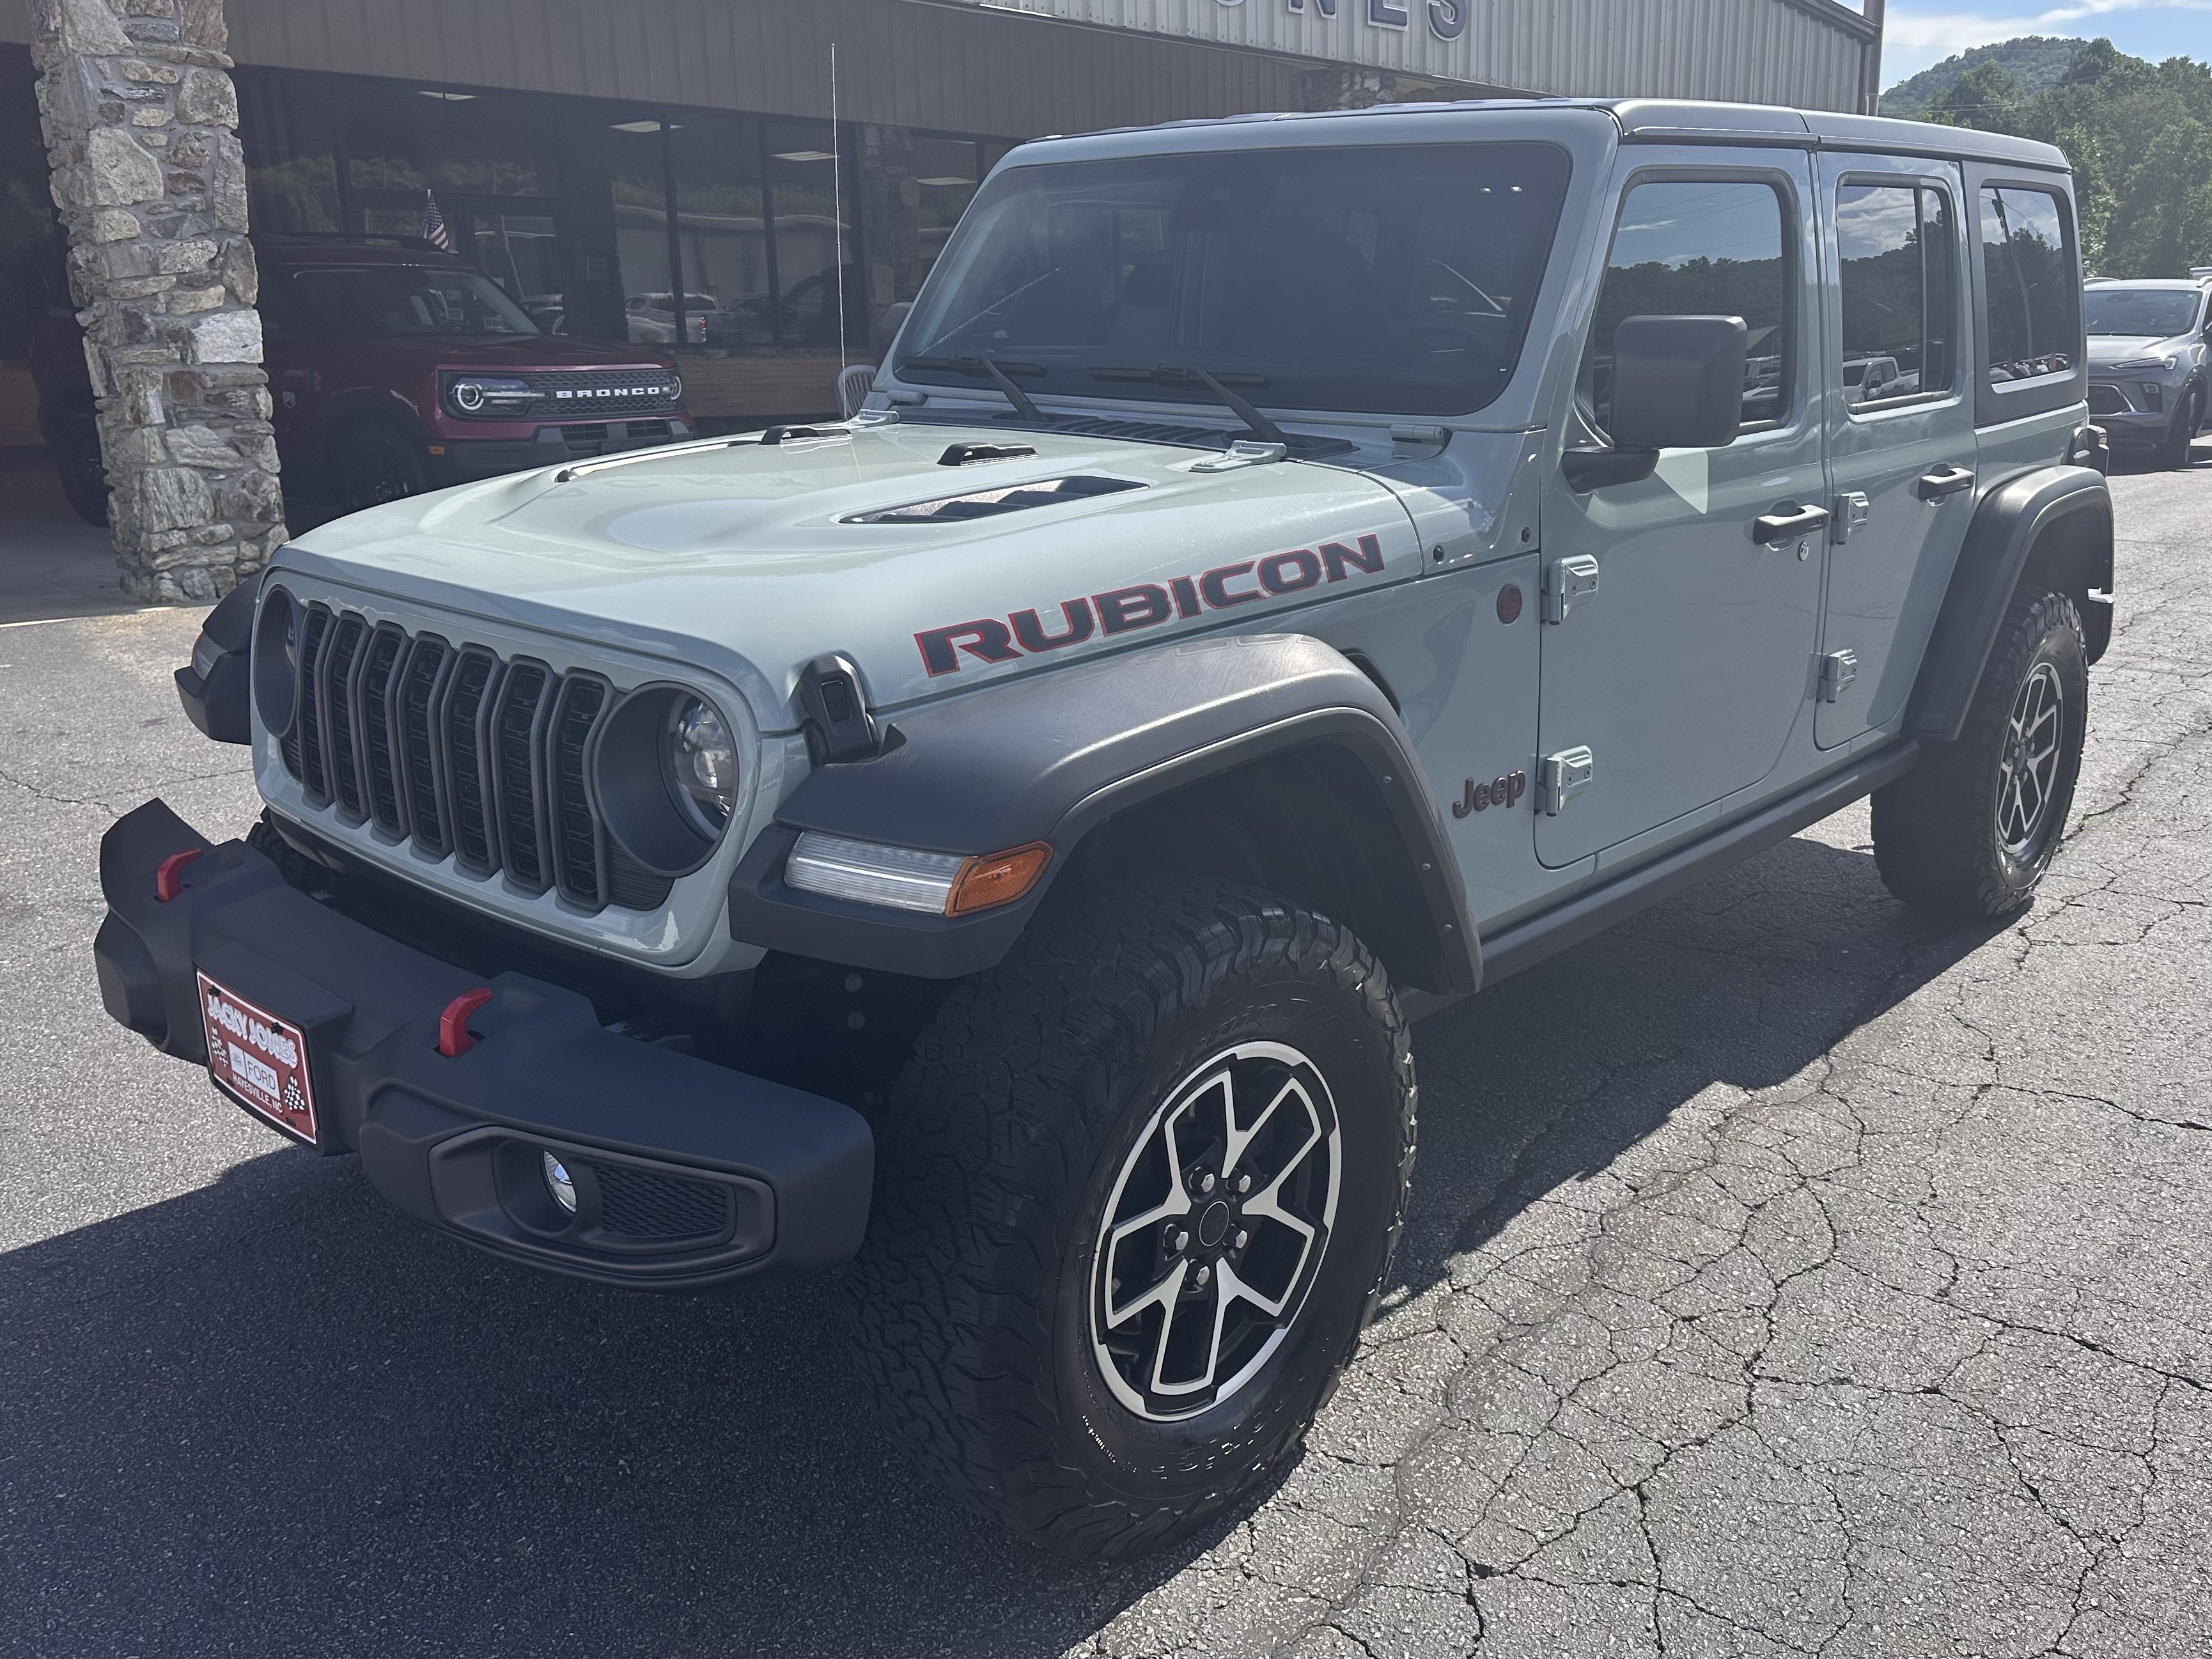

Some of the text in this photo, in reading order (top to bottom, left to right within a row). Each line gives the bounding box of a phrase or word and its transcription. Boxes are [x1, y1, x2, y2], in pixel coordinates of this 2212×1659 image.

[556, 387, 660, 398] BRONCO
[914, 533, 1385, 678] RUBICON
[1453, 769, 1526, 819] Jeep
[207, 993, 298, 1068] JACKY JONES
[247, 1063, 276, 1089] FORD
[272, 1101, 283, 1113] NC
